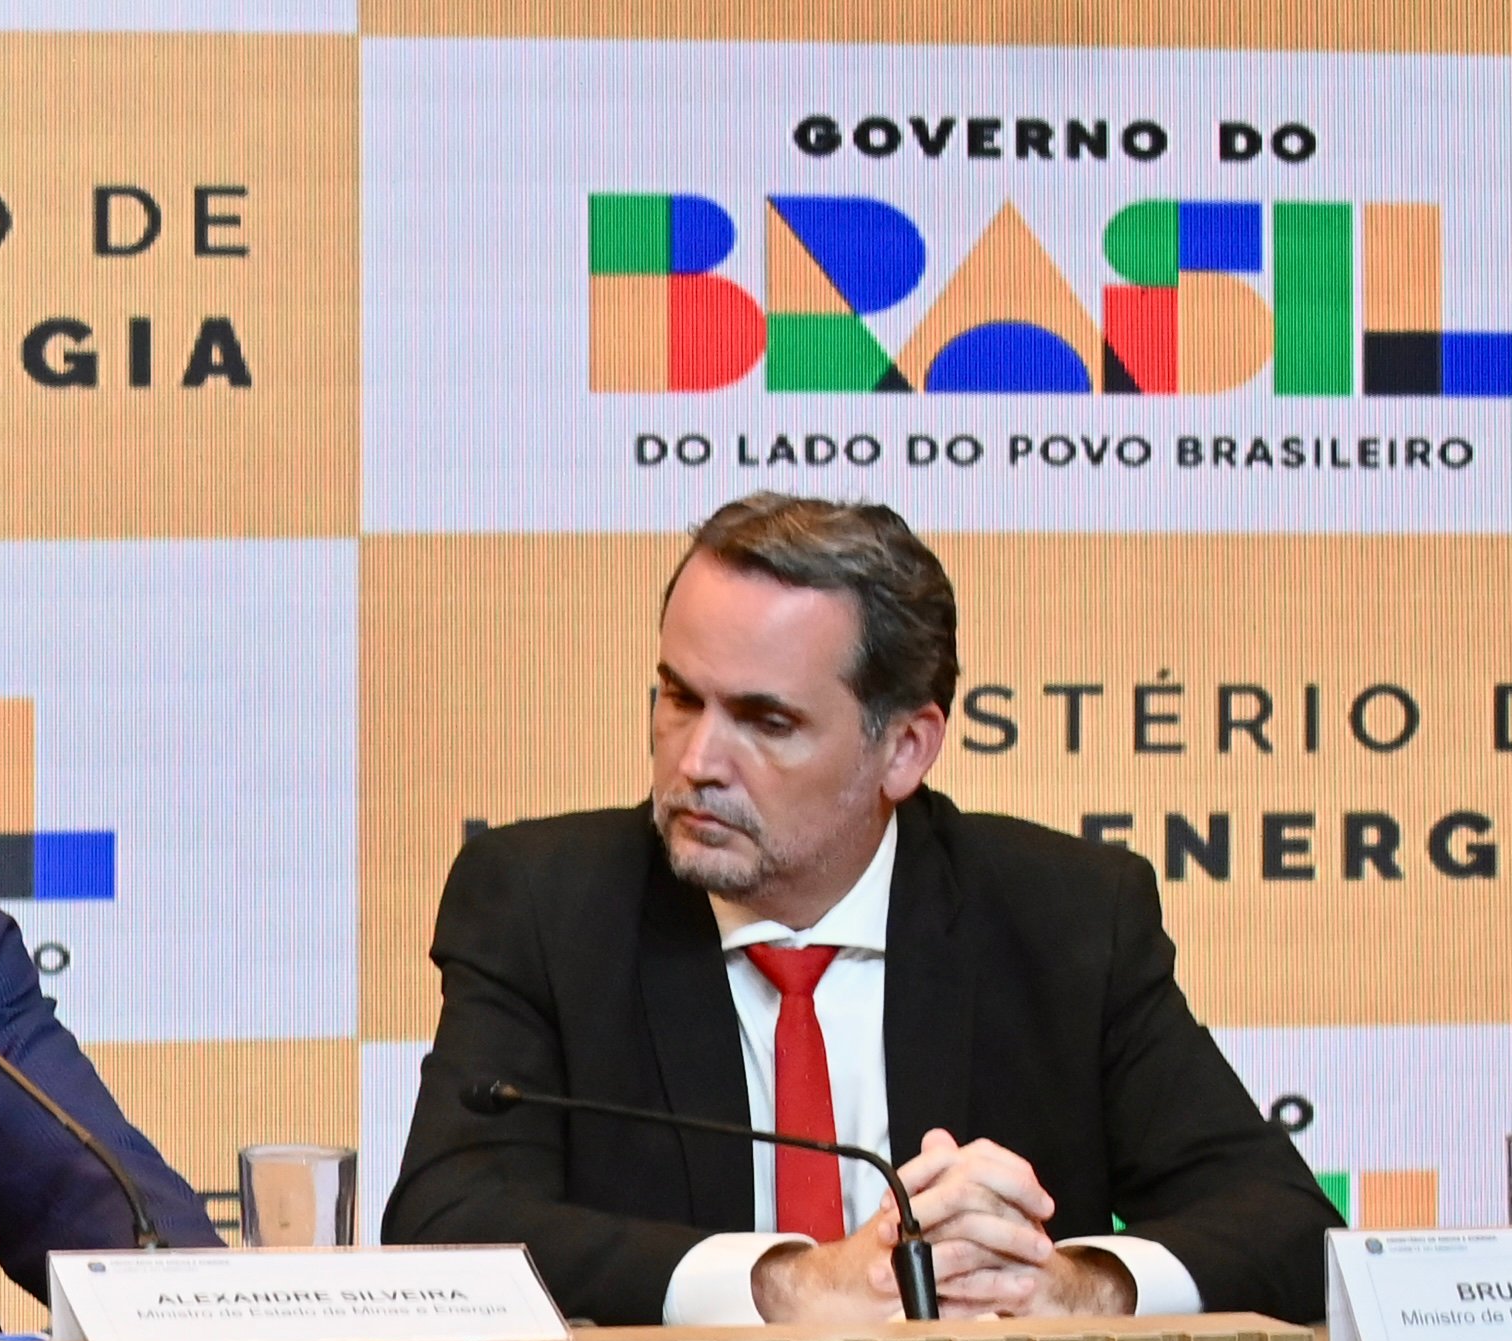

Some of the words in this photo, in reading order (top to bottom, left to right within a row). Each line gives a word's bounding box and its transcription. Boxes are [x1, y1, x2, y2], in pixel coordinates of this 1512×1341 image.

[793, 115, 1168, 162] GOVERNO
[1219, 122, 1317, 164] DO
[93, 185, 249, 258] DE
[634, 433, 713, 467] DO
[737, 434, 882, 467] LADO
[906, 434, 984, 467] DO
[1008, 434, 1153, 468] POVO
[1176, 436, 1475, 470] BRASILEIRO
[960, 669, 1420, 754] STÉRIO
[157, 1290, 330, 1306] ALEXANDRE
[340, 1289, 467, 1302] SILVEIRA
[1400, 1309, 1476, 1326] Ministro
[1480, 1308, 1505, 1324] de
